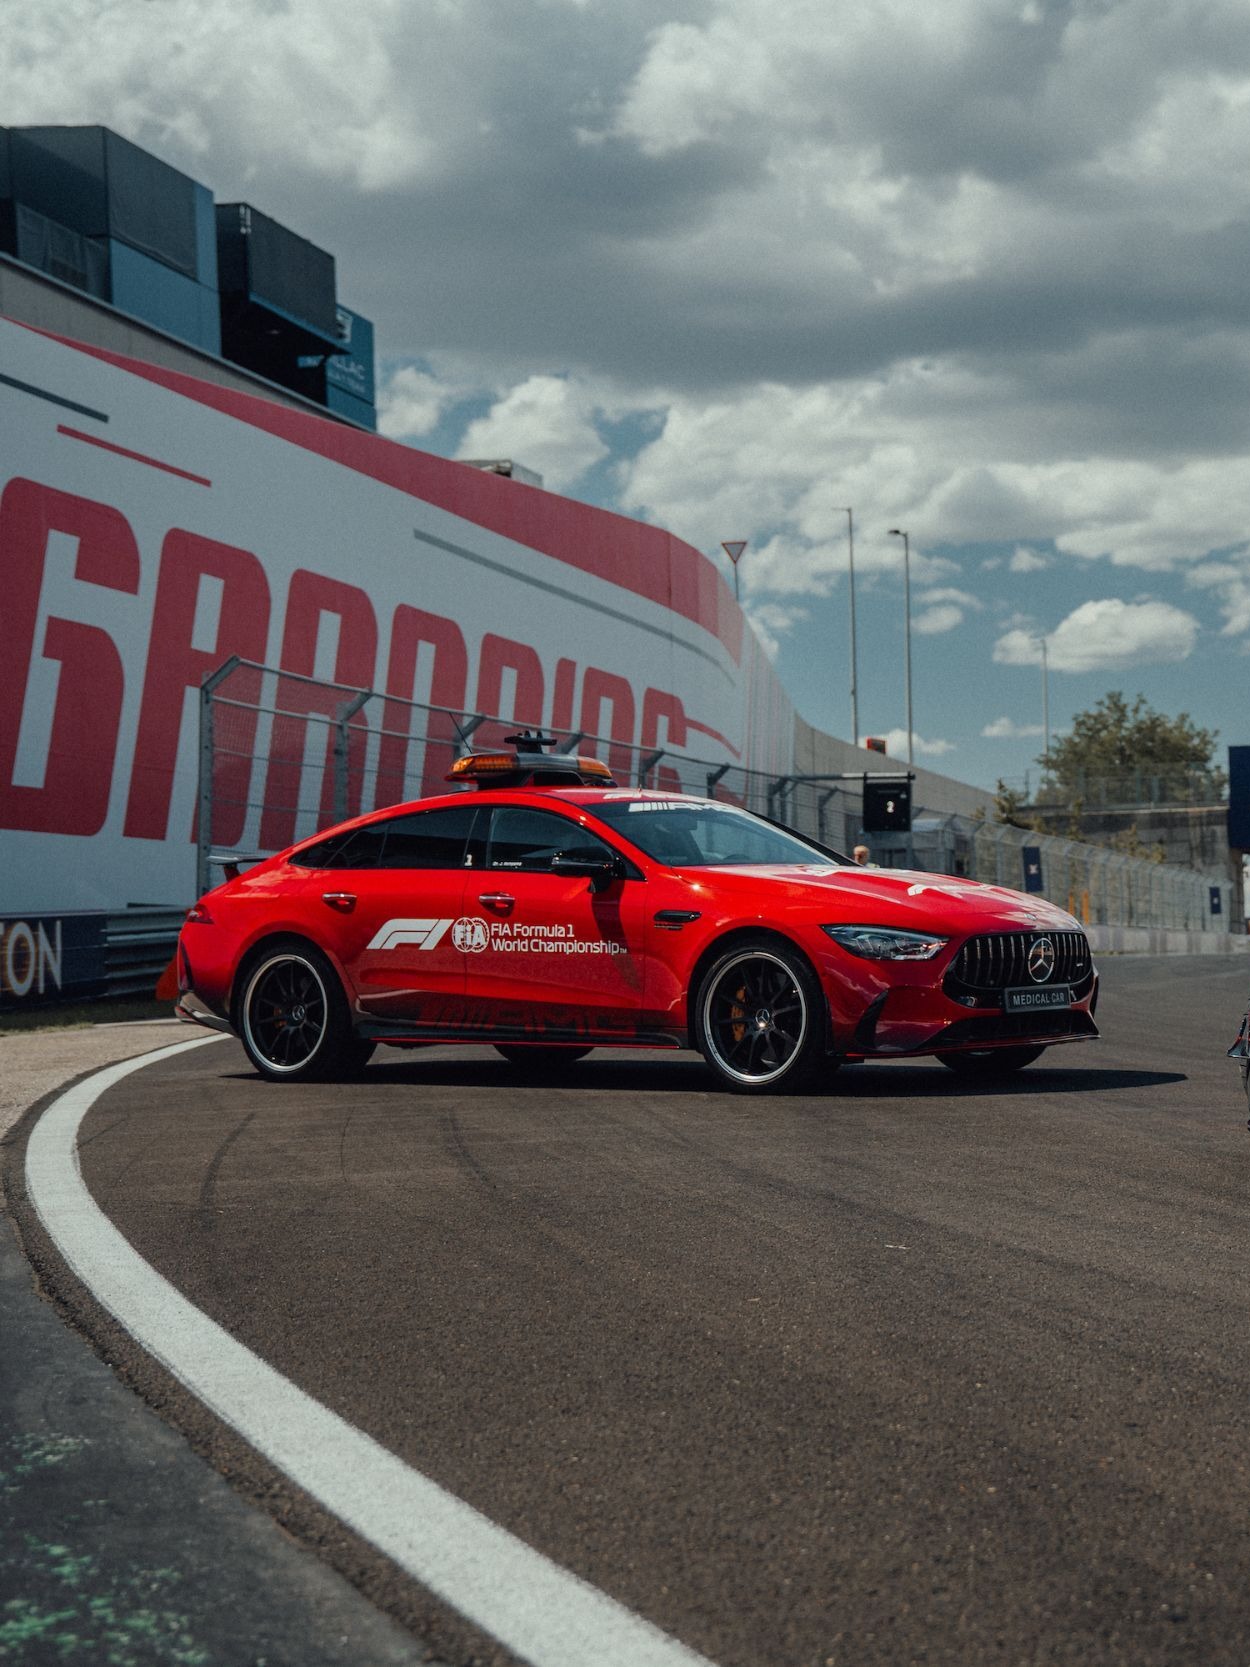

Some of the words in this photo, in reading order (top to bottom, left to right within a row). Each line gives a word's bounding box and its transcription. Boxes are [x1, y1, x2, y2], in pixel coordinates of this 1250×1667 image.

[491, 923, 511, 937] FIA
[513, 923, 566, 938] Formula
[567, 924, 575, 938] 1
[491, 938, 529, 952] World
[0, 921, 62, 996] ON
[1013, 994, 1050, 1006] MEDICAL
[1052, 993, 1065, 1003] CAR
